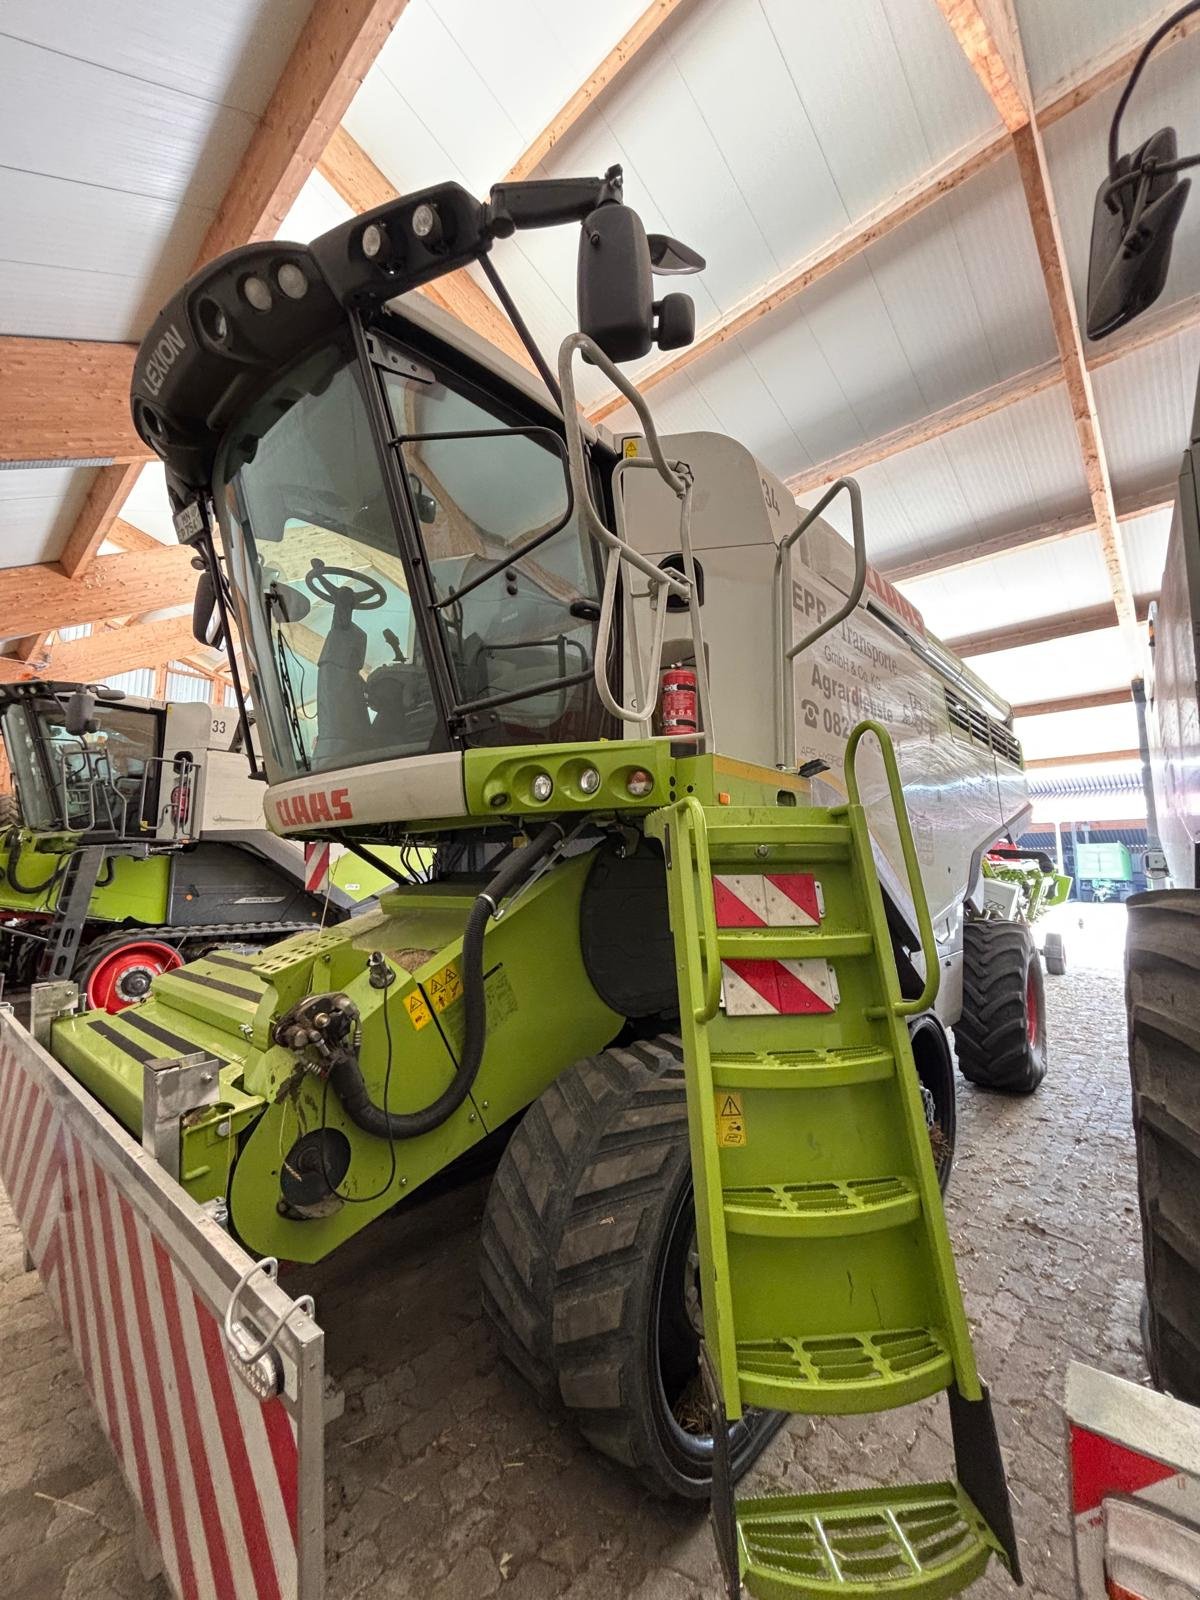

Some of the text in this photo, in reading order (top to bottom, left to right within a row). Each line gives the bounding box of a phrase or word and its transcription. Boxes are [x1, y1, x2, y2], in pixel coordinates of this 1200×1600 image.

[142, 323, 186, 396] LEXION
[761, 478, 780, 516] 34
[824, 645, 850, 673] GmbH
[850, 660, 857, 677] &
[842, 618, 898, 676] Transporte
[811, 663, 894, 723] Agrardienste
[212, 719, 226, 734] 33
[276, 788, 353, 827] CLAAS
